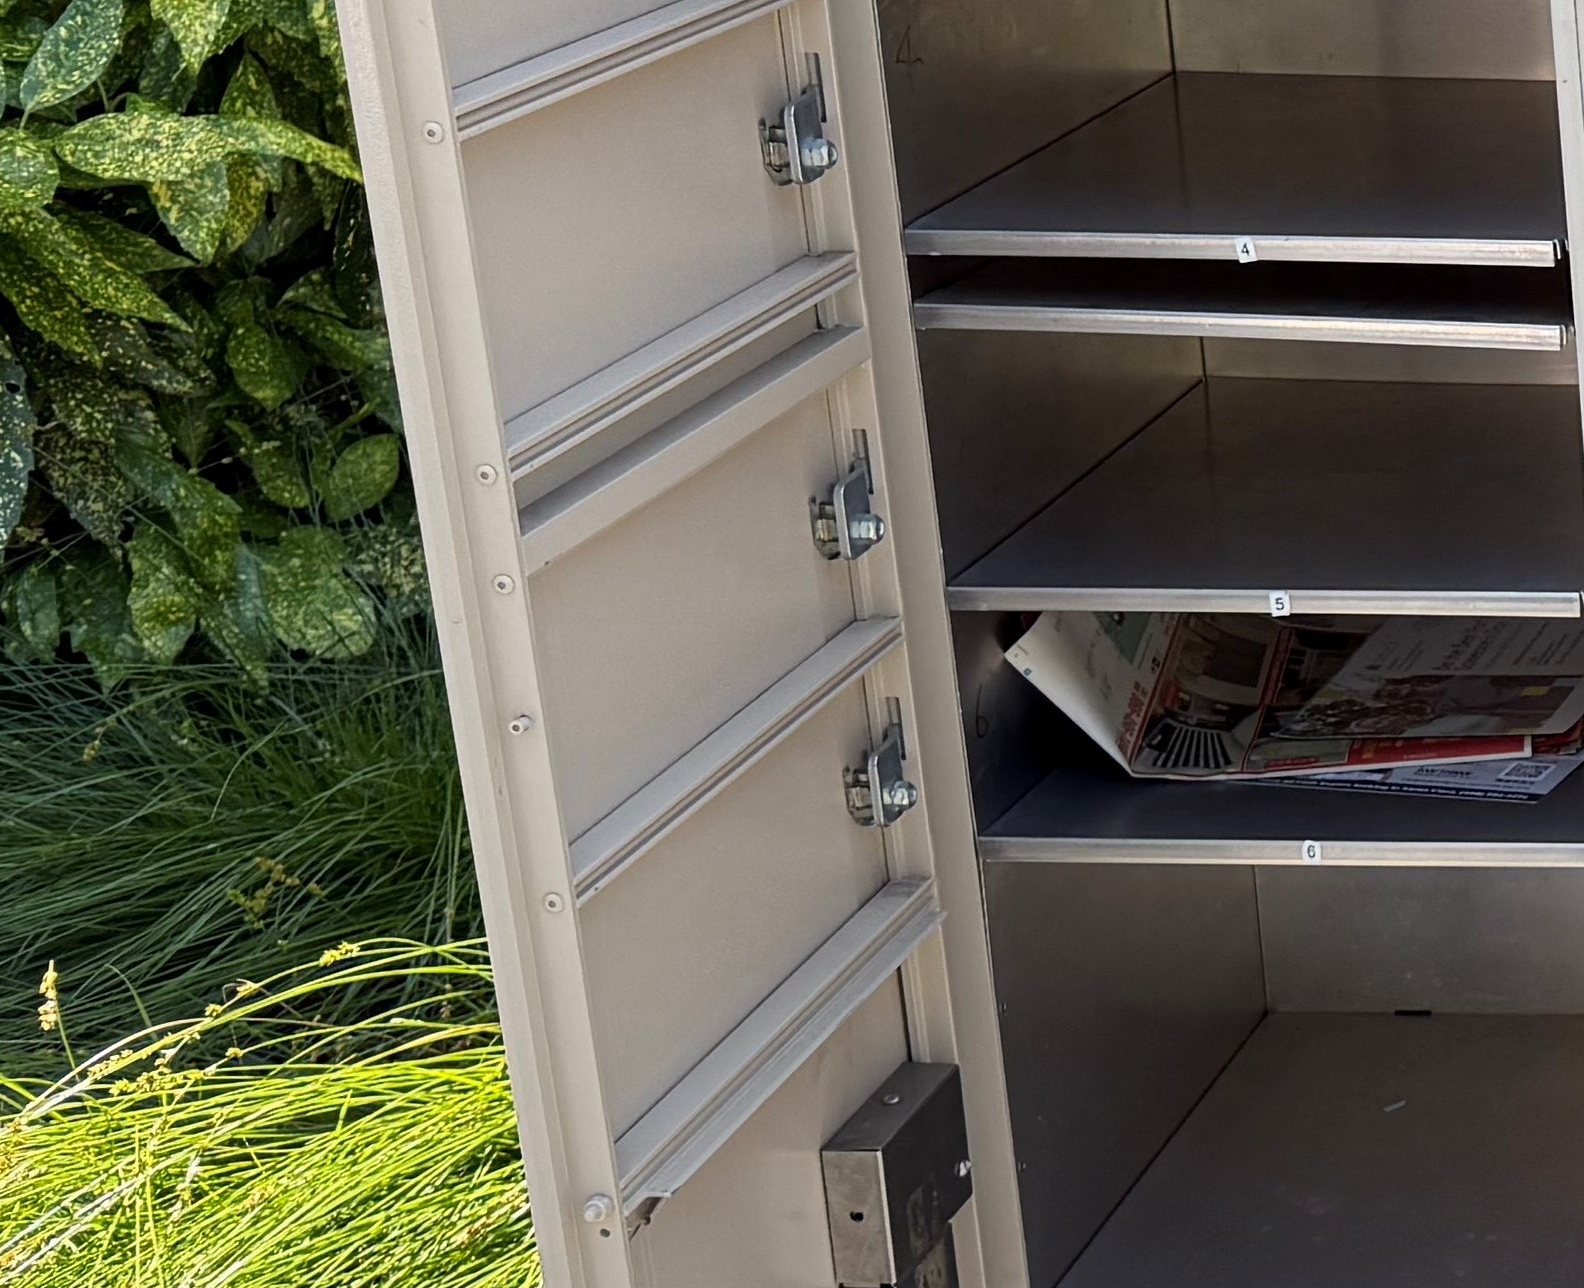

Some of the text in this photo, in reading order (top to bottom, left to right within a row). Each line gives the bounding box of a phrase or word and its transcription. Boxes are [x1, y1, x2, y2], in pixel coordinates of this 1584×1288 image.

[1241, 242, 1250, 256] 4
[1274, 597, 1285, 611] 5
[1306, 844, 1316, 859] 6
